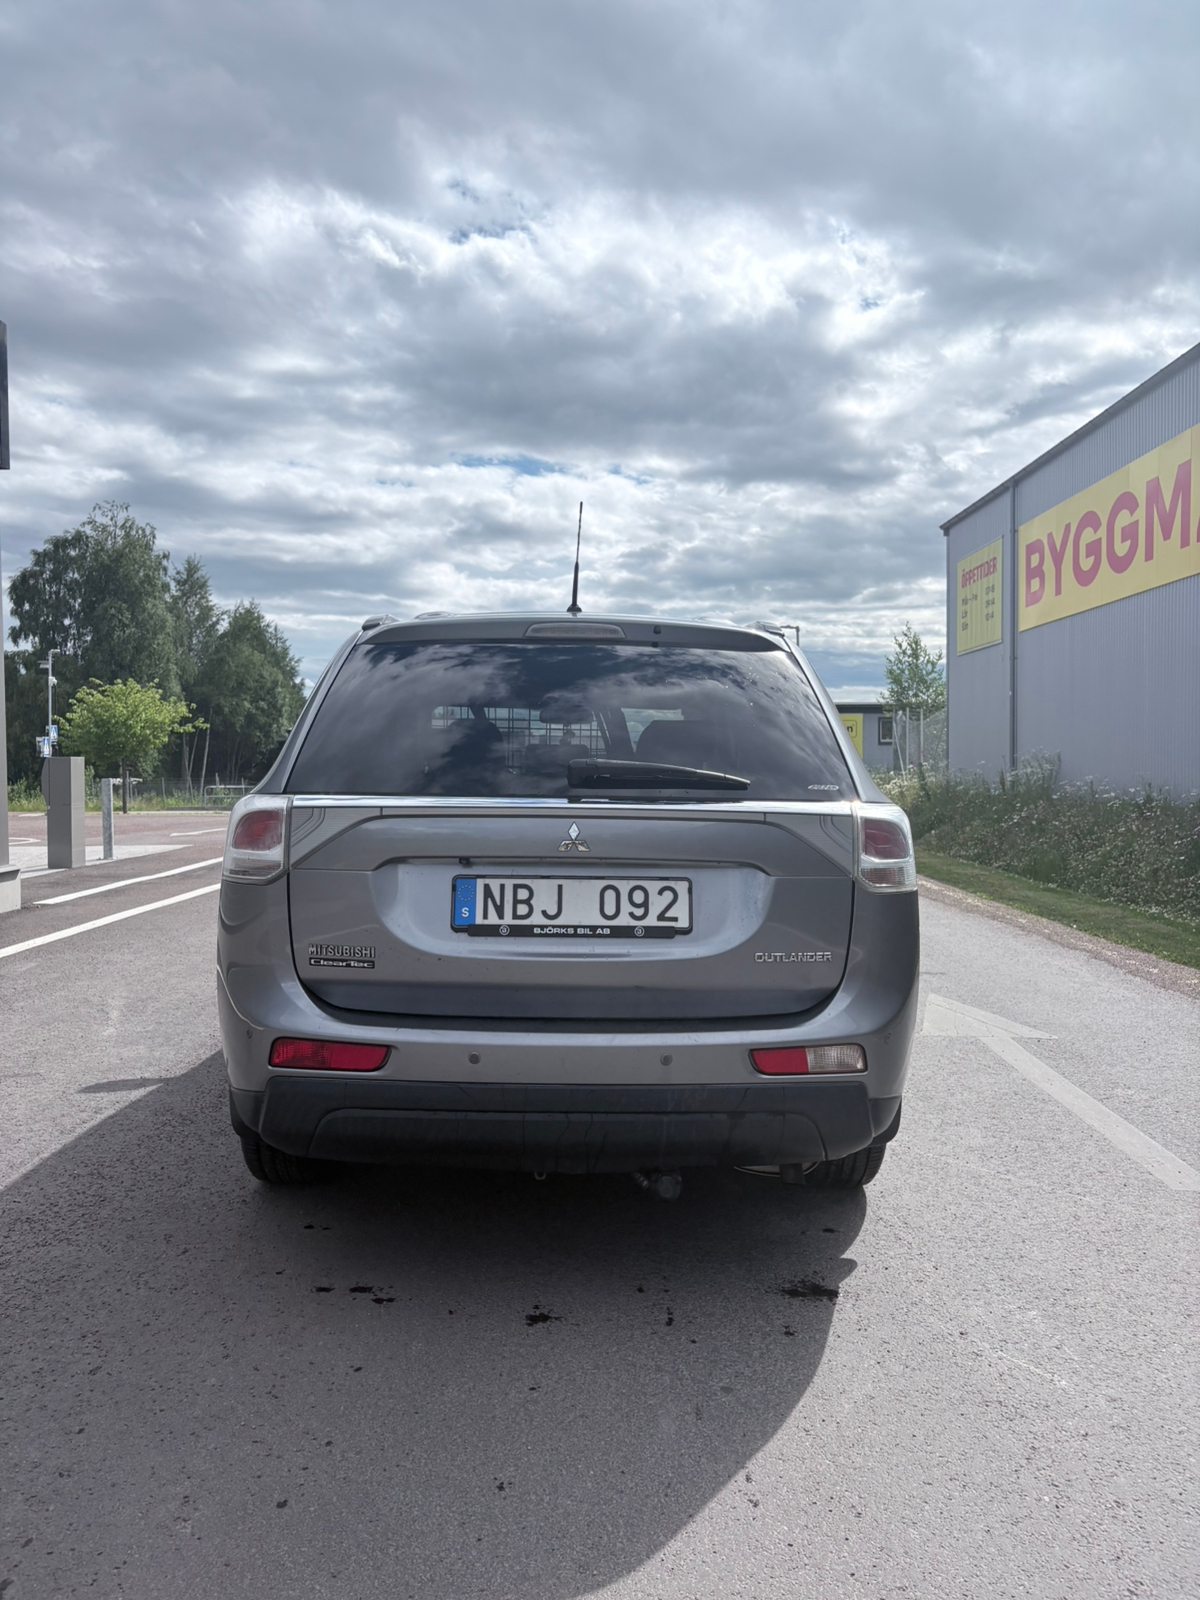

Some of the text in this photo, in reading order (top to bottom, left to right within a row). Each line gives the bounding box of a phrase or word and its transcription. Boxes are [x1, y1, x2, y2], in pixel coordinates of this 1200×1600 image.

[1024, 458, 1200, 608] BYGGM
[961, 556, 997, 589] ÖPPETTIDER
[461, 883, 679, 922] S NBJ 092
[533, 926, 611, 935] BJÖRKS BIL AB
[308, 943, 376, 959] MITSUBISHI
[754, 952, 832, 962] OUTLANDER
[310, 959, 374, 968] ClearTec
